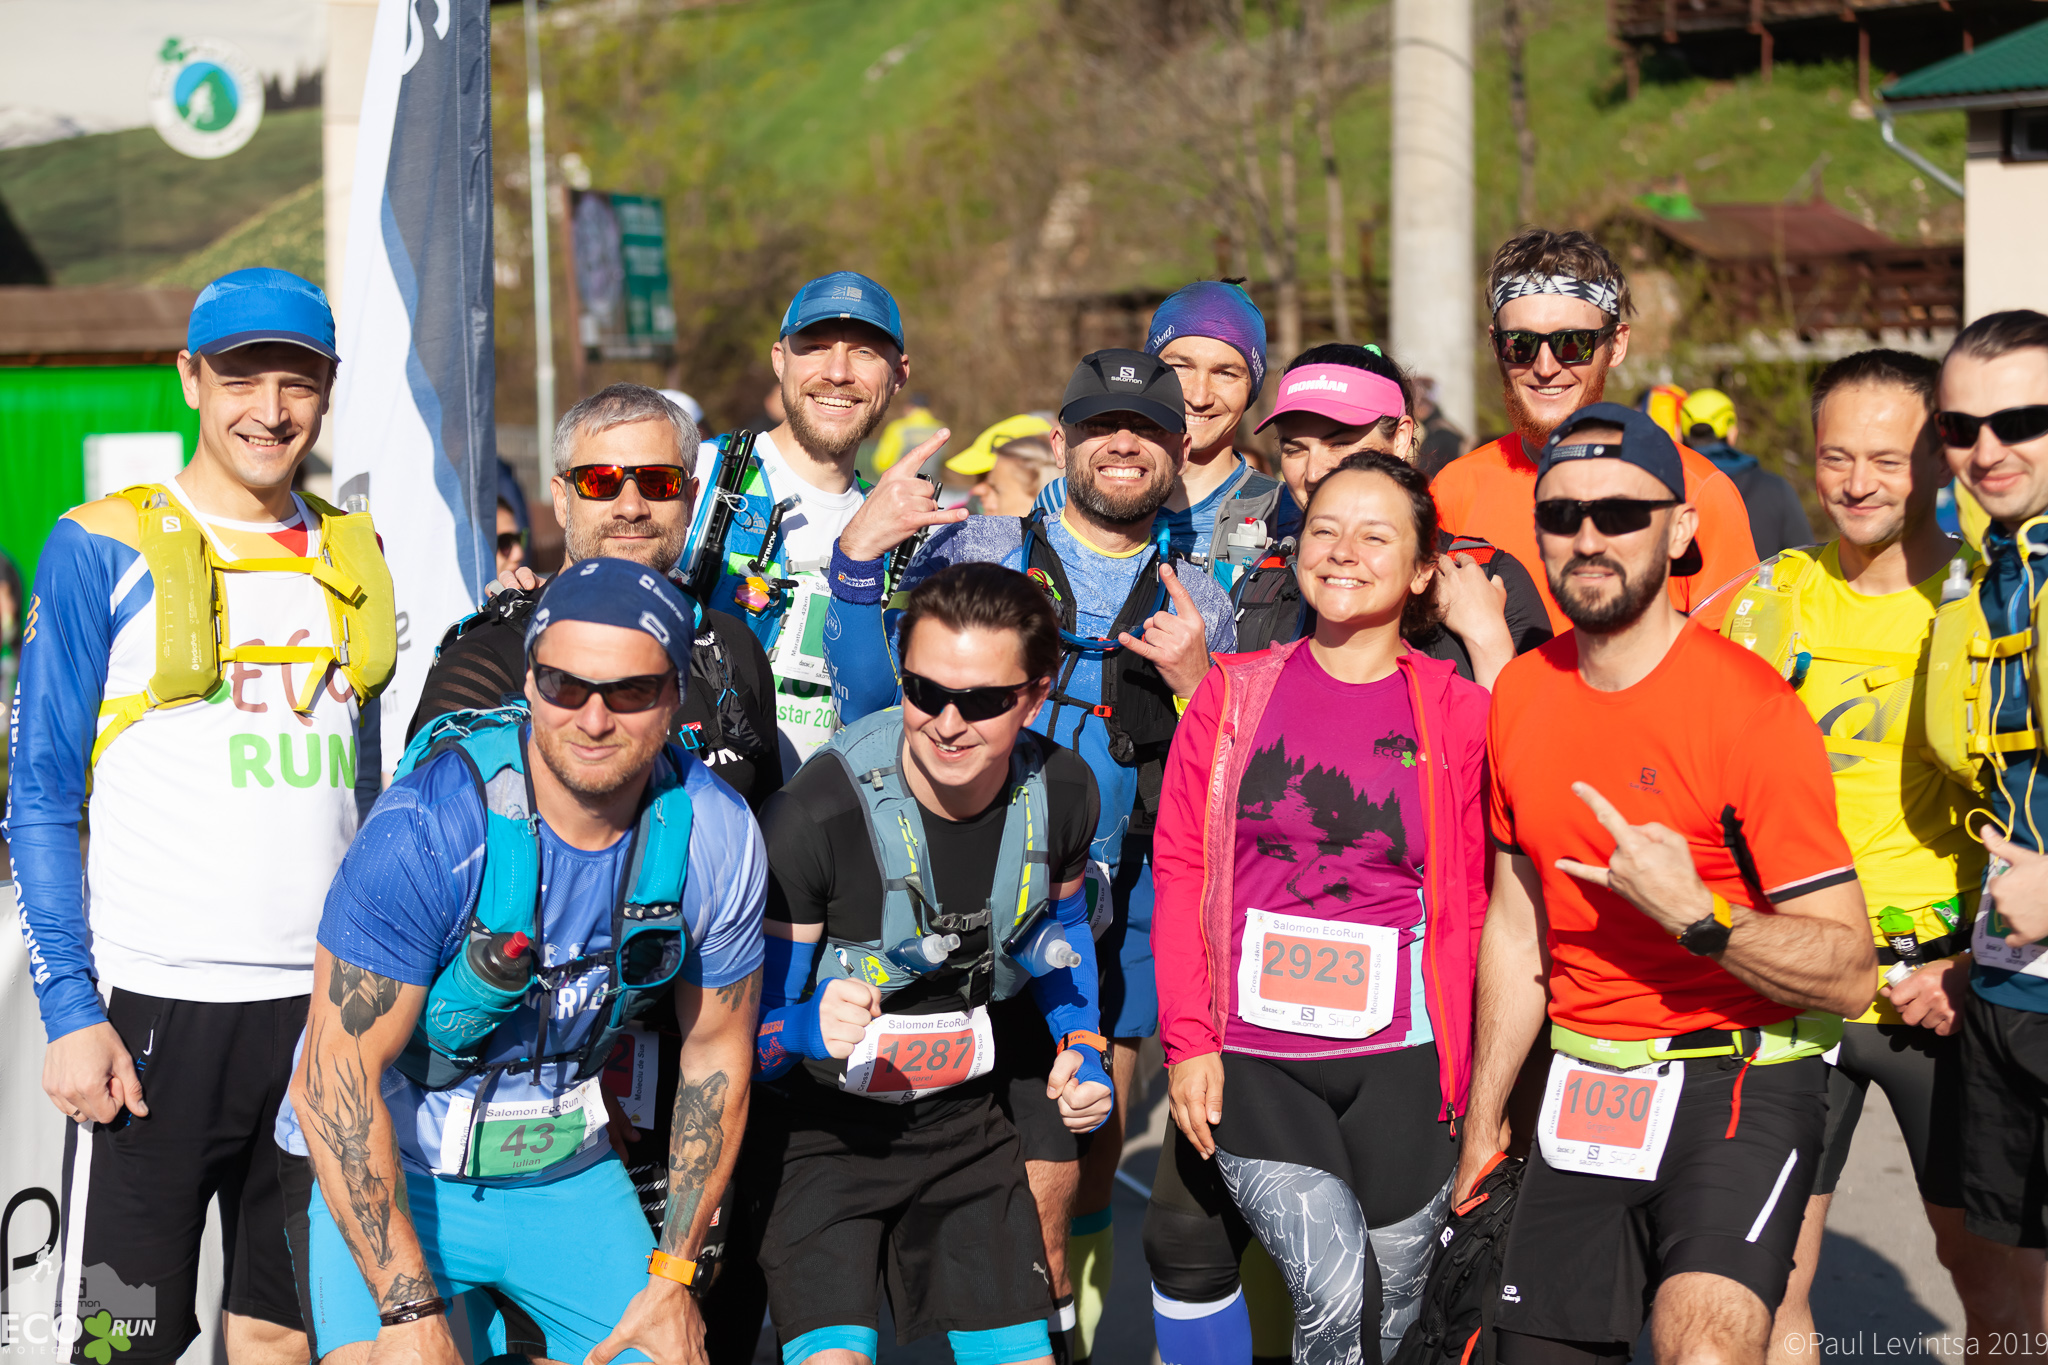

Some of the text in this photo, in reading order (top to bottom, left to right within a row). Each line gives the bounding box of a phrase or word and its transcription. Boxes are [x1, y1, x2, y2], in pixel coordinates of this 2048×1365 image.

[1110, 376, 1143, 385] salomon
[1286, 374, 1349, 396] IRONMAN
[229, 733, 357, 790] RUN
[1373, 746, 1403, 759] ECO
[1273, 919, 1365, 940] Salomon EcoRun
[1262, 940, 1366, 986] 2923
[1250, 970, 1258, 994] Cross
[1370, 953, 1382, 1015] Moieciu de Sus
[888, 1018, 970, 1030] Salomon EcoRun
[637, 1044, 645, 1059] Sus
[882, 1036, 973, 1073] 1287
[636, 1060, 645, 1070] de
[857, 1072, 870, 1092] Cross
[865, 1043, 874, 1065] 14km
[486, 1097, 579, 1118] Salomon EcoRun
[1567, 1077, 1651, 1122] 1030
[500, 1122, 556, 1157] 43
[512, 1157, 541, 1169] Iulian
